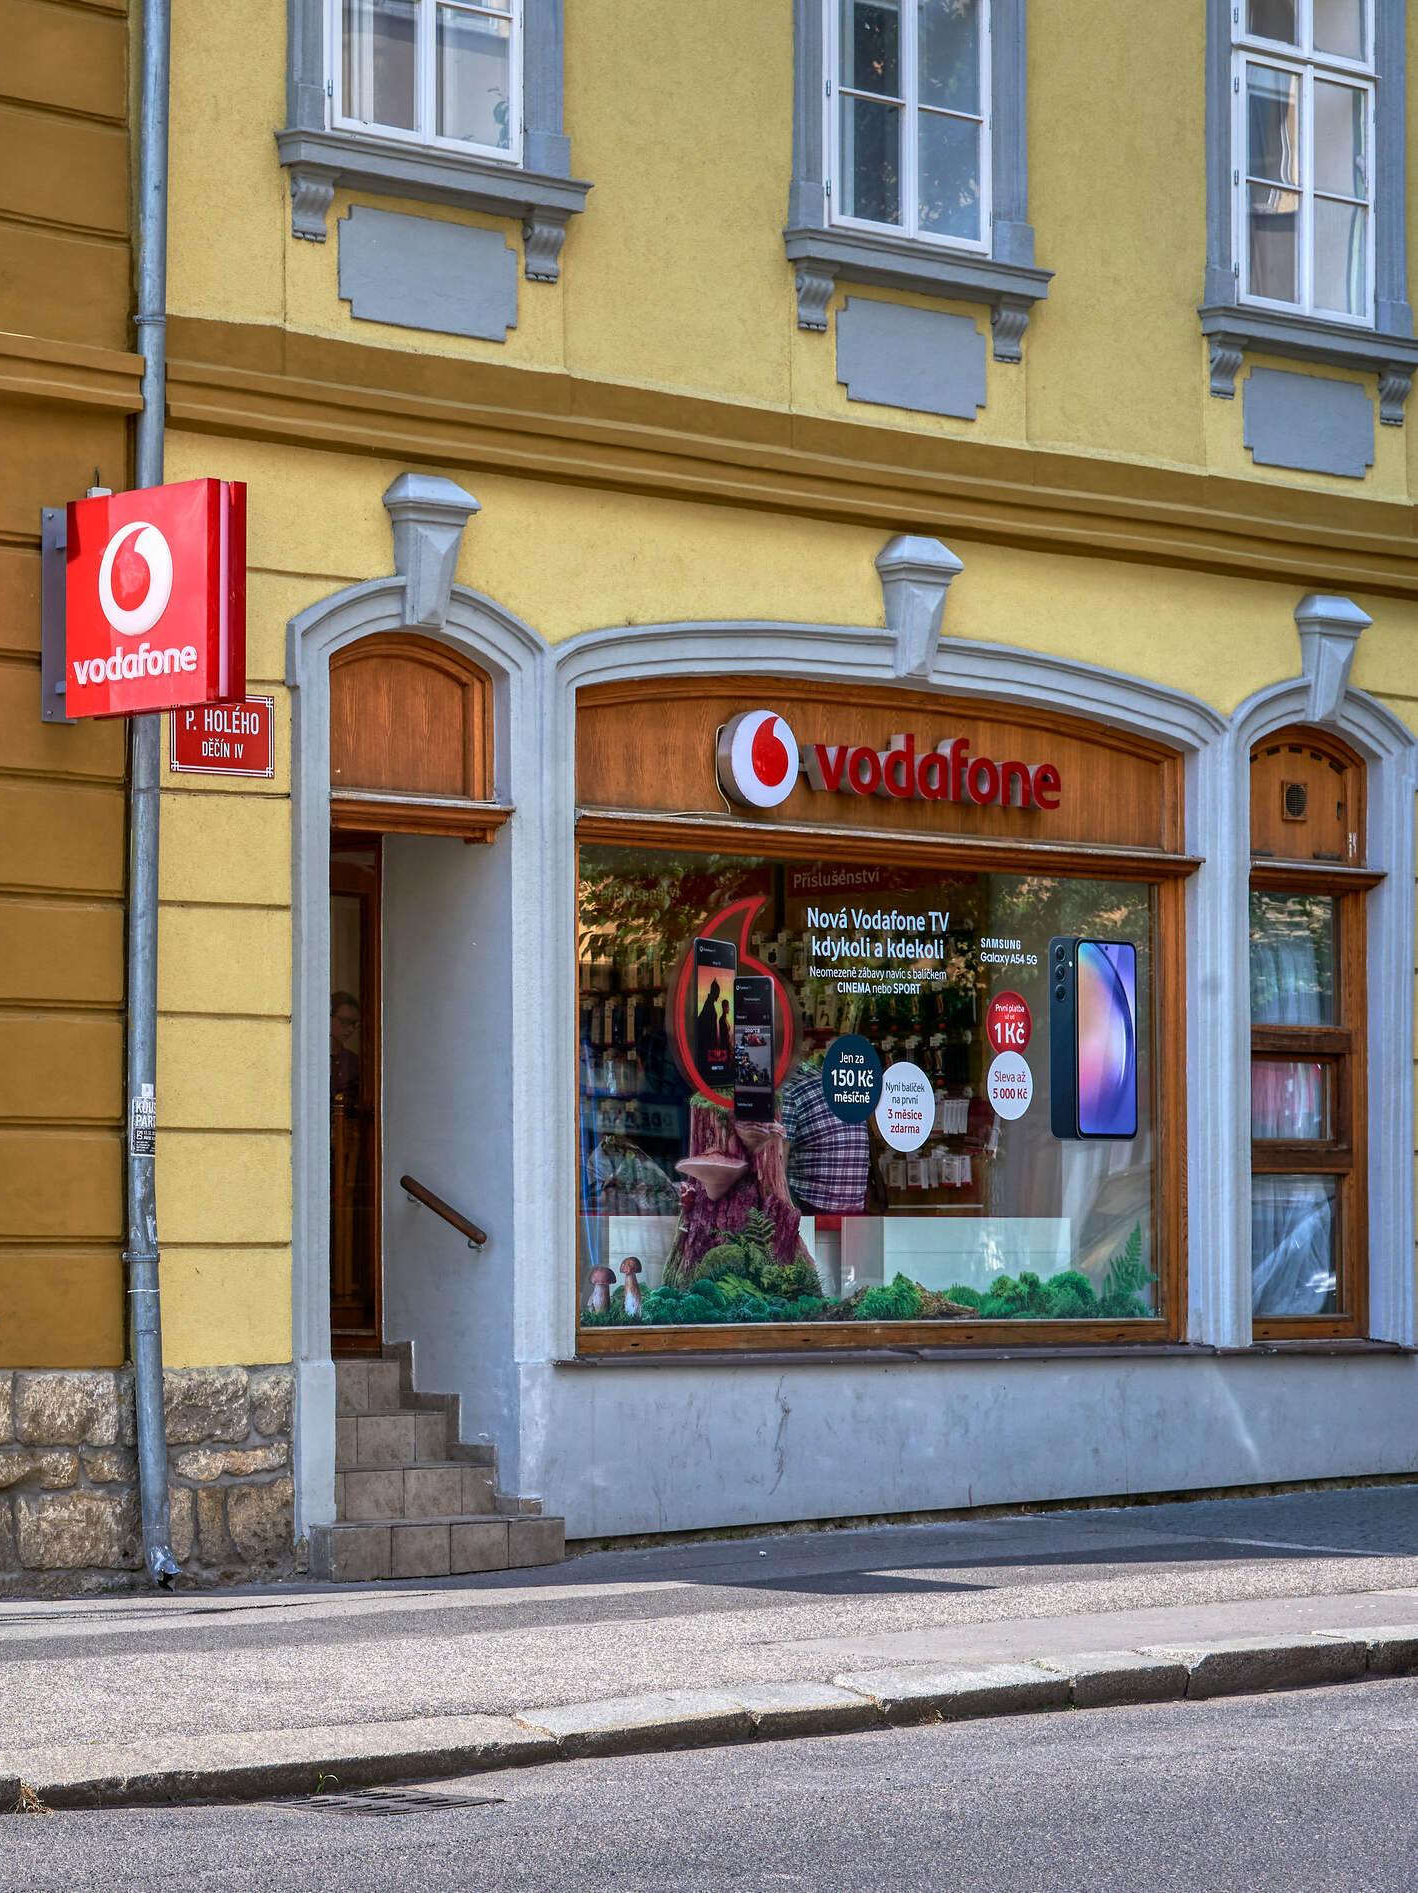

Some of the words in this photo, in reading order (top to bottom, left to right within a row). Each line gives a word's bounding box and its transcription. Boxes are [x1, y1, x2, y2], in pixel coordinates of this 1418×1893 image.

[73, 642, 198, 685] vodafone
[185, 709, 197, 731] P.
[204, 705, 260, 735] HOLÉHO
[201, 738, 230, 758] DĚČÍN
[234, 743, 244, 759] IV
[812, 733, 1062, 811] vodafone
[807, 907, 848, 929] Nová
[851, 909, 926, 931] Vodafone
[928, 911, 950, 932] TV
[812, 935, 870, 962] kdykoli
[874, 942, 883, 958] a
[887, 937, 944, 959] kdekoli
[980, 937, 1021, 950] SAMSUNG
[980, 951, 1010, 966] Galaxy
[1010, 953, 1025, 965] A54
[1026, 954, 1038, 965] 5G
[858, 967, 884, 981] zábavy
[886, 968, 906, 980] navíc
[907, 970, 912, 980] s
[913, 968, 947, 981] balíčkem
[837, 982, 871, 994] CINEMA
[872, 983, 892, 994] nebo
[893, 983, 922, 995] SPORT
[994, 1022, 1002, 1044] 1
[1005, 1021, 1025, 1044] Kč
[839, 1052, 854, 1064] Jen
[855, 1055, 864, 1064] za
[831, 1069, 855, 1087] 150
[857, 1070, 874, 1088] Kč
[994, 1071, 1015, 1082] Sleva
[1017, 1071, 1027, 1083] až
[885, 1082, 901, 1094] Nyní
[901, 1083, 925, 1093] balíček
[993, 1088, 998, 1099] 5
[999, 1088, 1015, 1099] 000
[1017, 1088, 1028, 1100] Kč
[834, 1090, 870, 1104] měsíčně
[901, 1095, 919, 1106] první
[887, 1109, 893, 1119] 3
[894, 1109, 923, 1120] měsíce
[890, 1123, 920, 1134] zdarma
